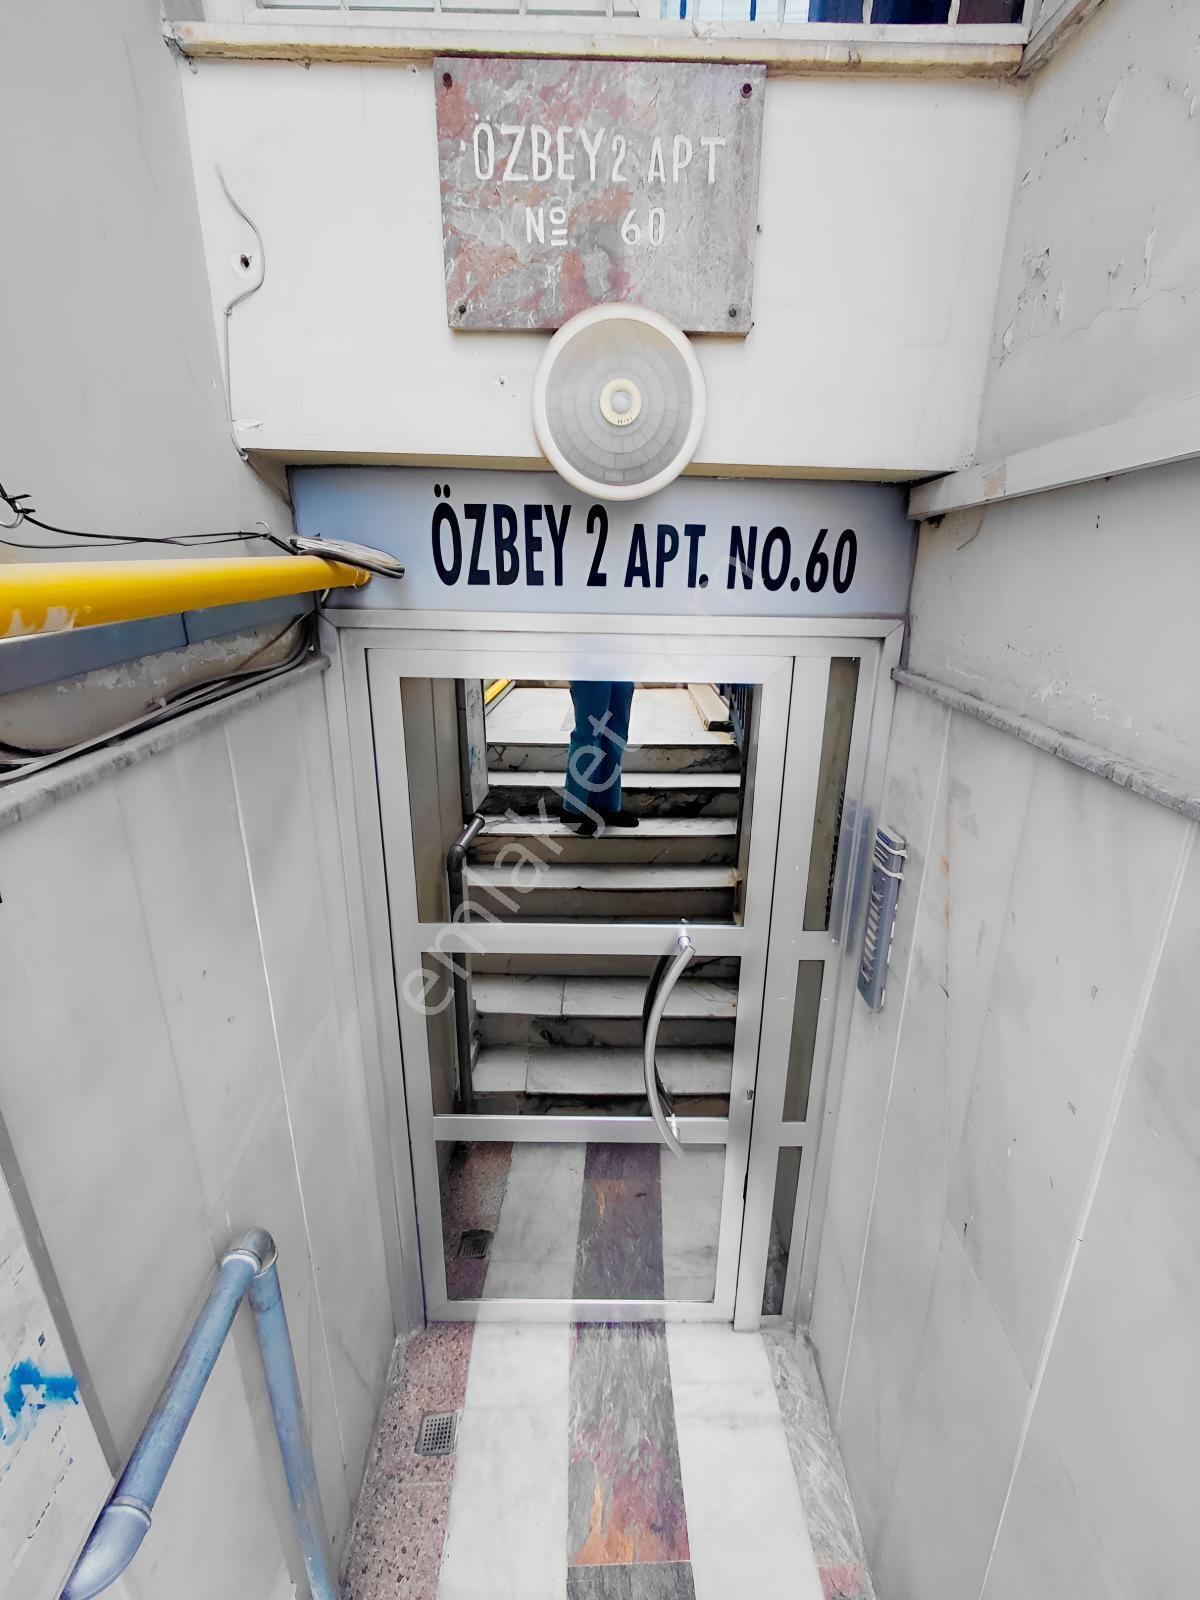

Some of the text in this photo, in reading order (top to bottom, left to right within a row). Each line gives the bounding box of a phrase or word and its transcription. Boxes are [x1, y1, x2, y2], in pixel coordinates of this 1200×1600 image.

[648, 134, 727, 184] APT
[621, 208, 665, 246] 60
[431, 483, 572, 587] ÖZBEY
[586, 504, 608, 587] 2
[624, 523, 709, 588] APT.
